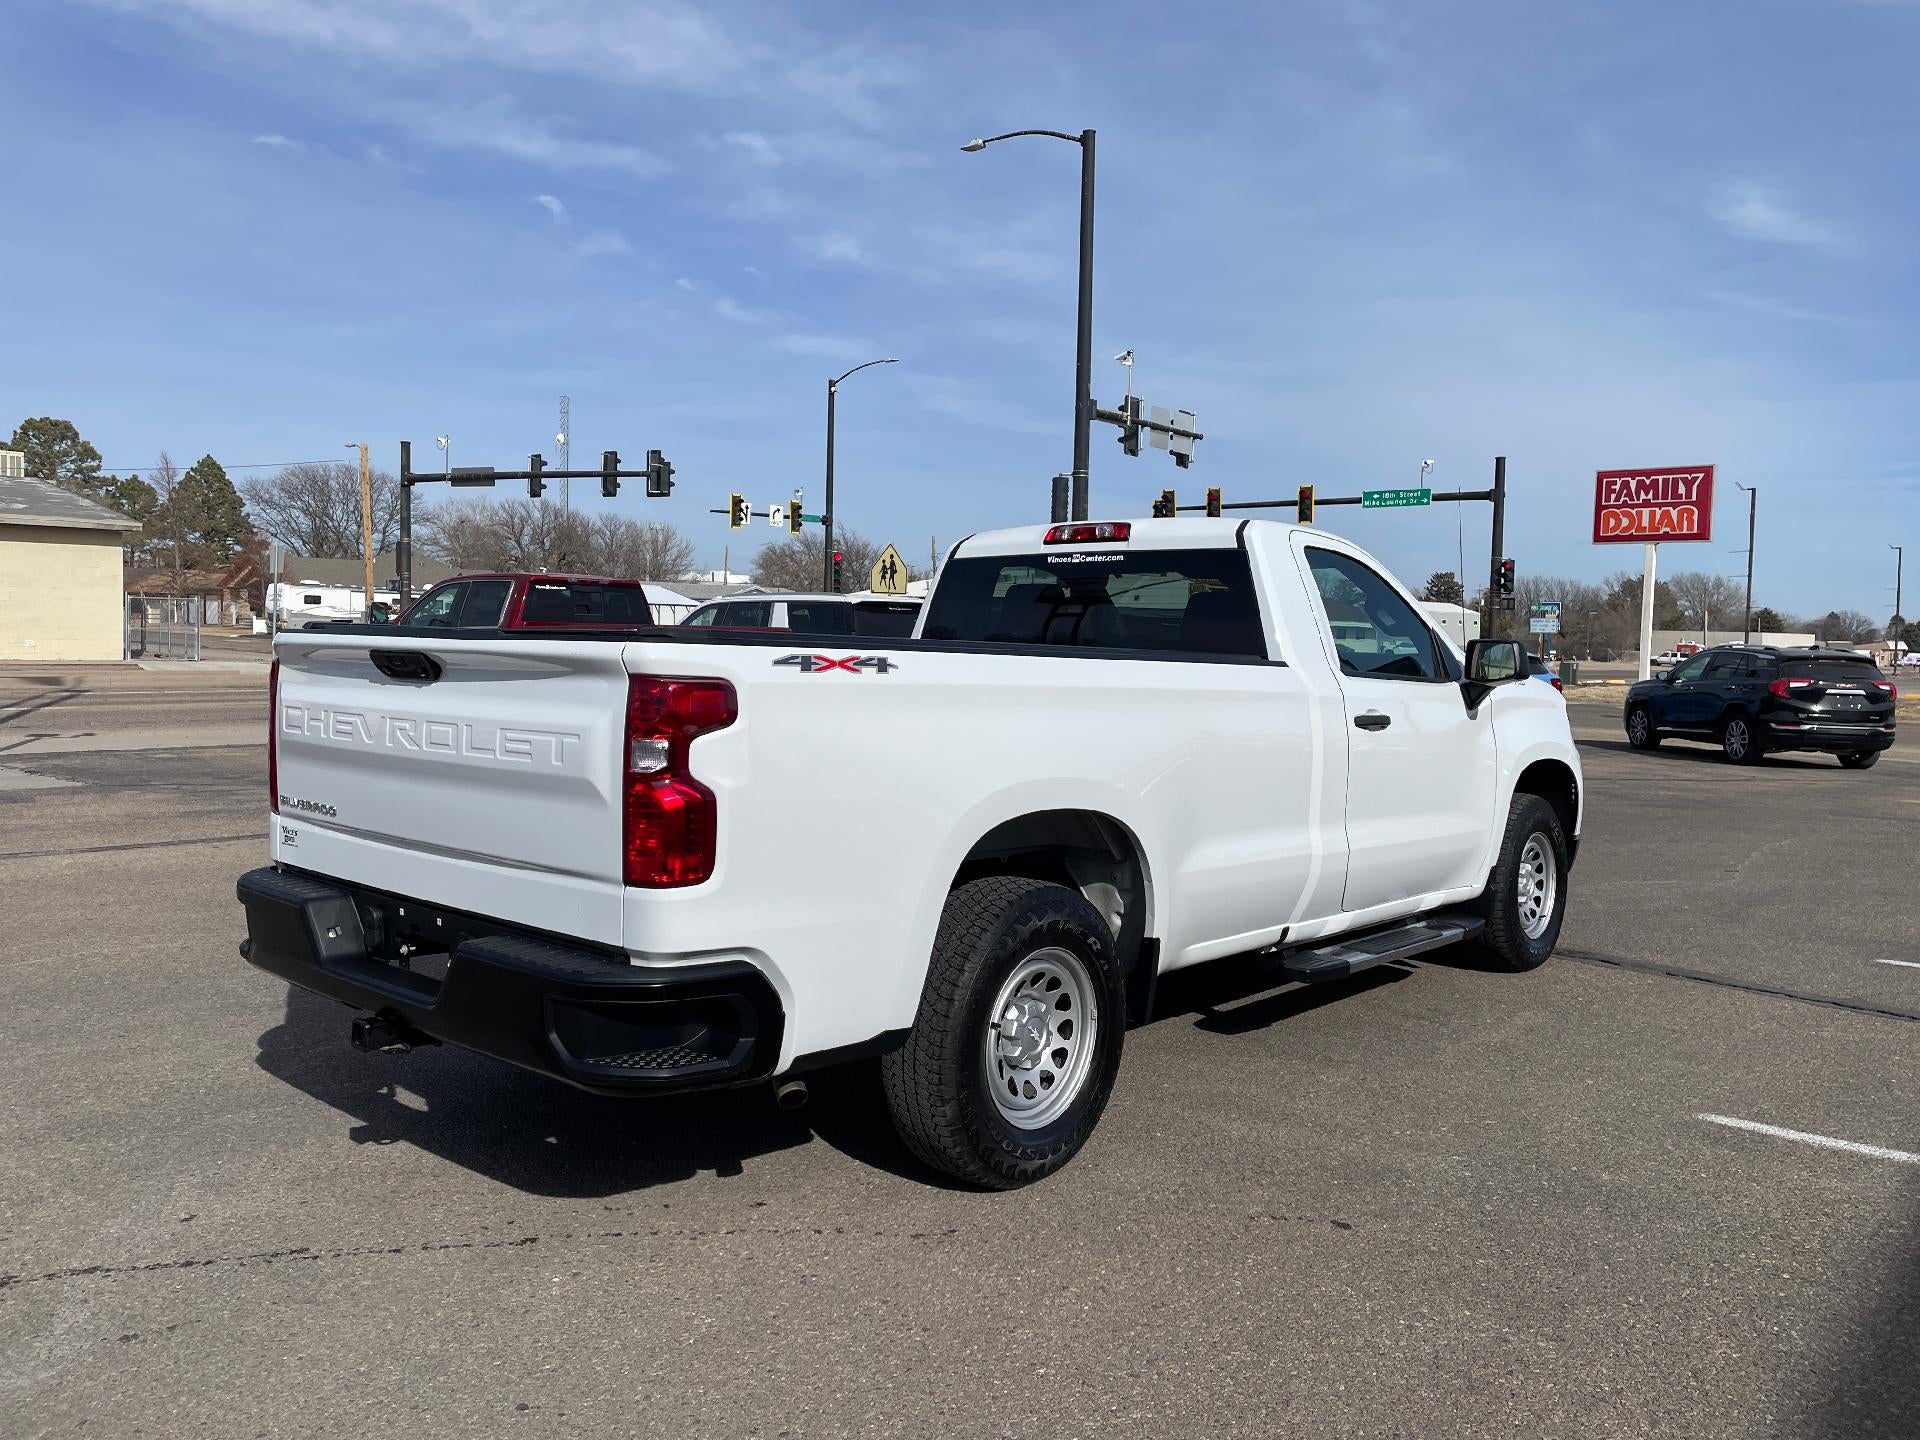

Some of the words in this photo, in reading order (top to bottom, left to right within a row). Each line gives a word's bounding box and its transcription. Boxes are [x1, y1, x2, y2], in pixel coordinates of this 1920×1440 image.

[1602, 473, 1704, 505] FAMILY
[1600, 505, 1698, 536] DOLLAR
[282, 705, 580, 766] CHEVROLET
